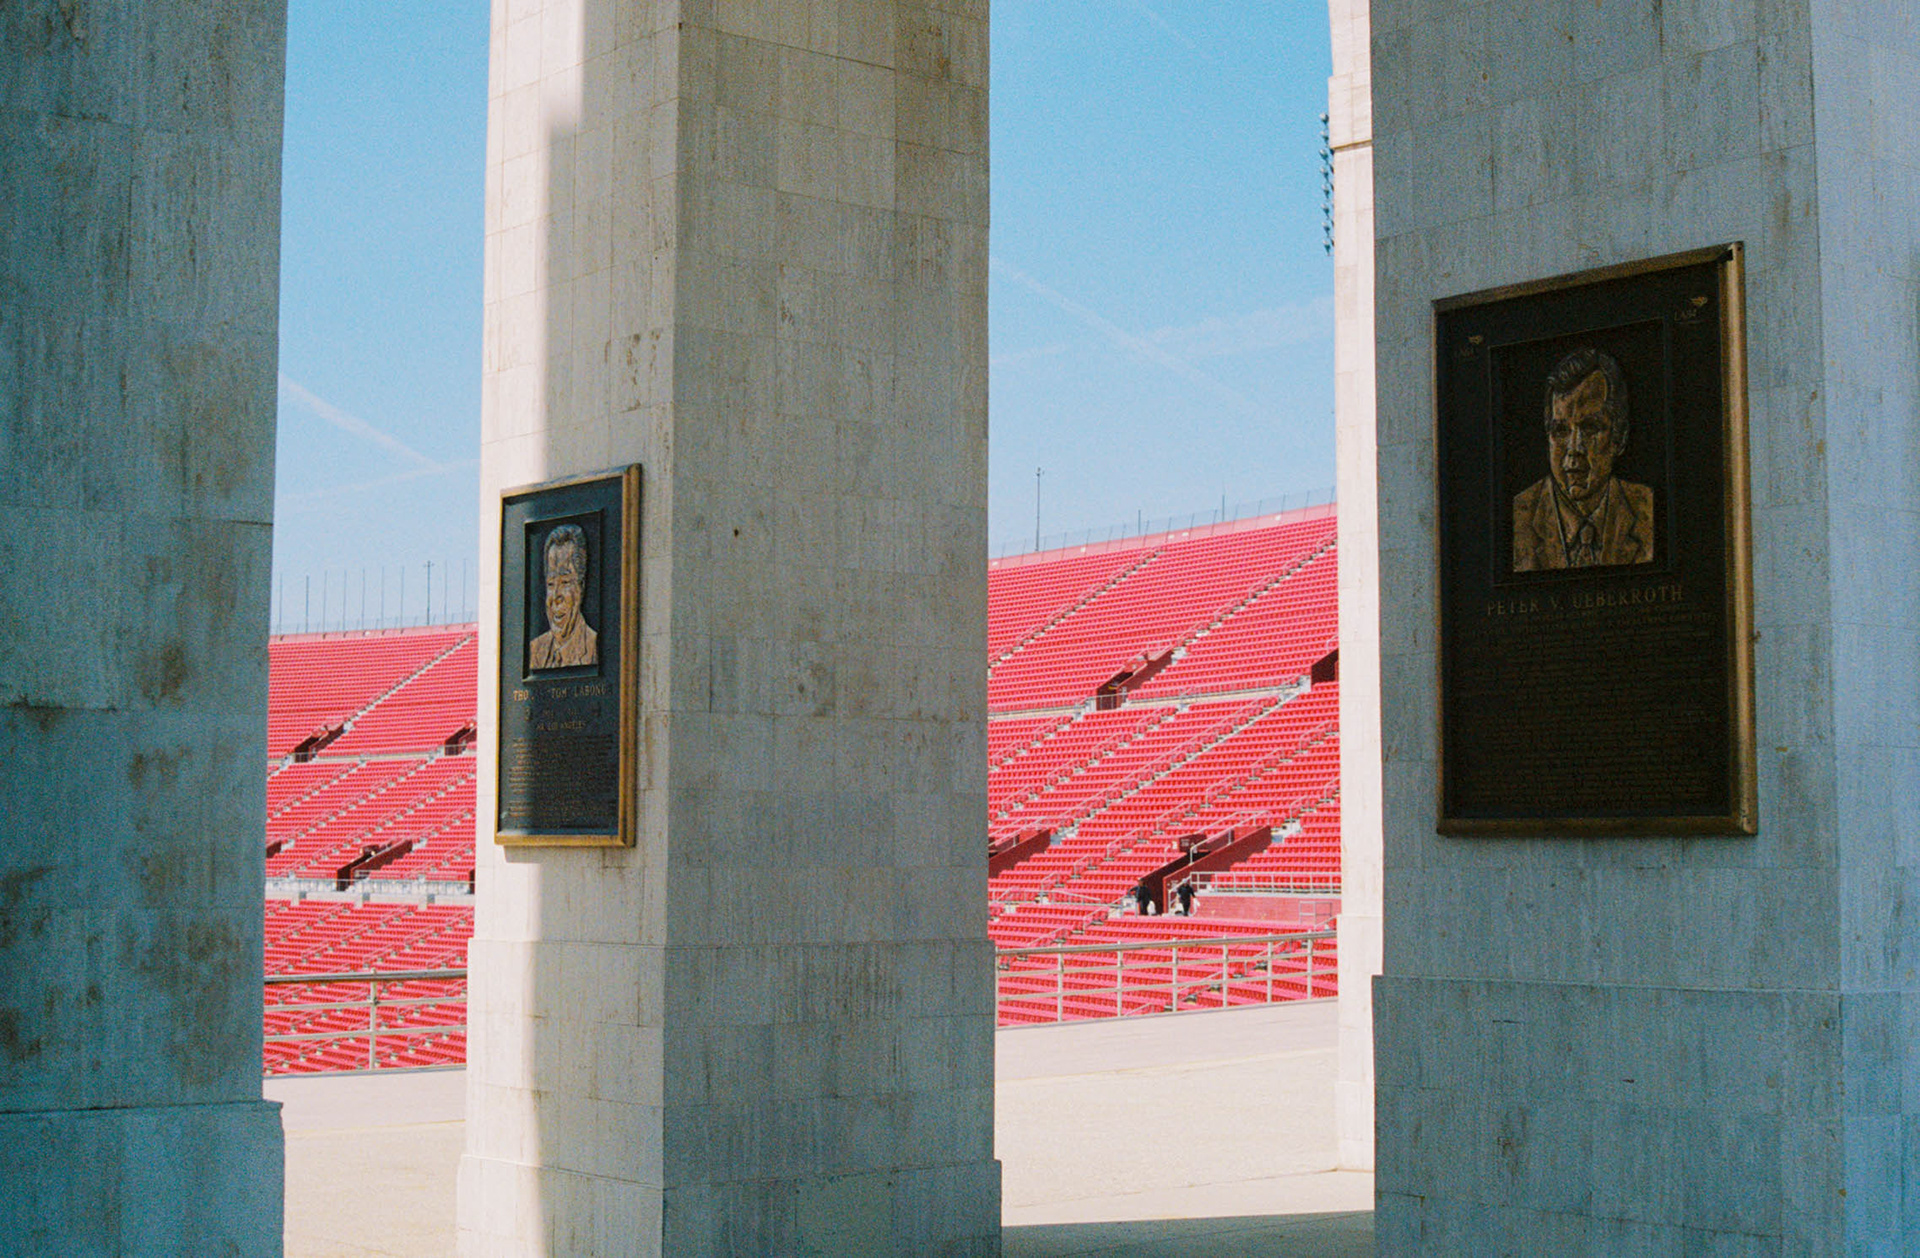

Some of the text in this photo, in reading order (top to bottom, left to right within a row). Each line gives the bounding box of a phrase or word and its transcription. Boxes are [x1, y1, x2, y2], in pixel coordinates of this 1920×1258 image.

[1487, 584, 1684, 616] PETER V. UEBERROTH
